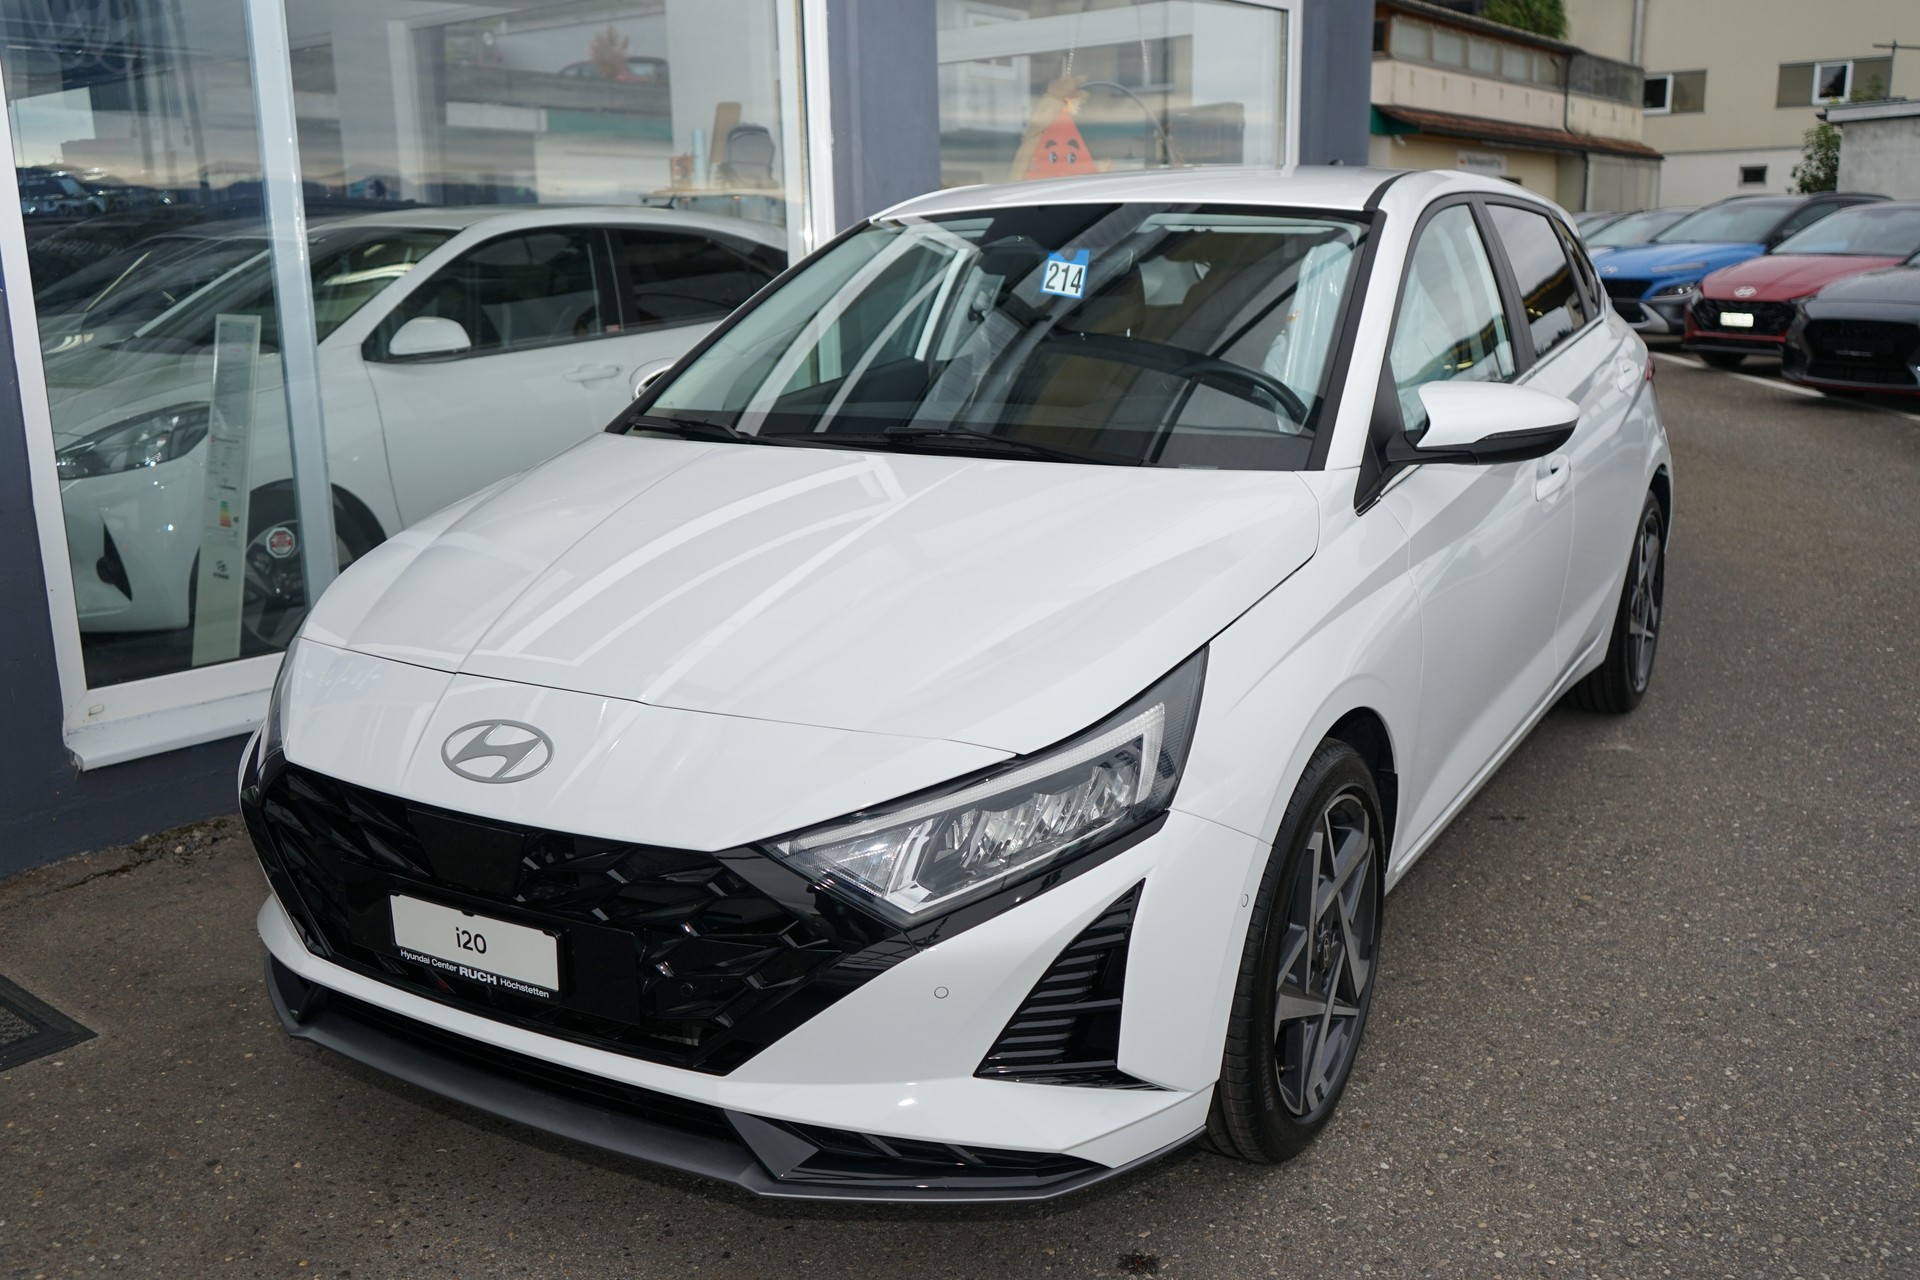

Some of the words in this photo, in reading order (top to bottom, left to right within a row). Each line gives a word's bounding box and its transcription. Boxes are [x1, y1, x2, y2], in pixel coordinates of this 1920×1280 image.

[1045, 263, 1083, 293] 214
[455, 927, 487, 954] i20
[400, 949, 430, 965] Hyundai
[432, 957, 458, 972] Center
[459, 966, 497, 985] RUCH
[500, 978, 549, 999] Höchstetten
